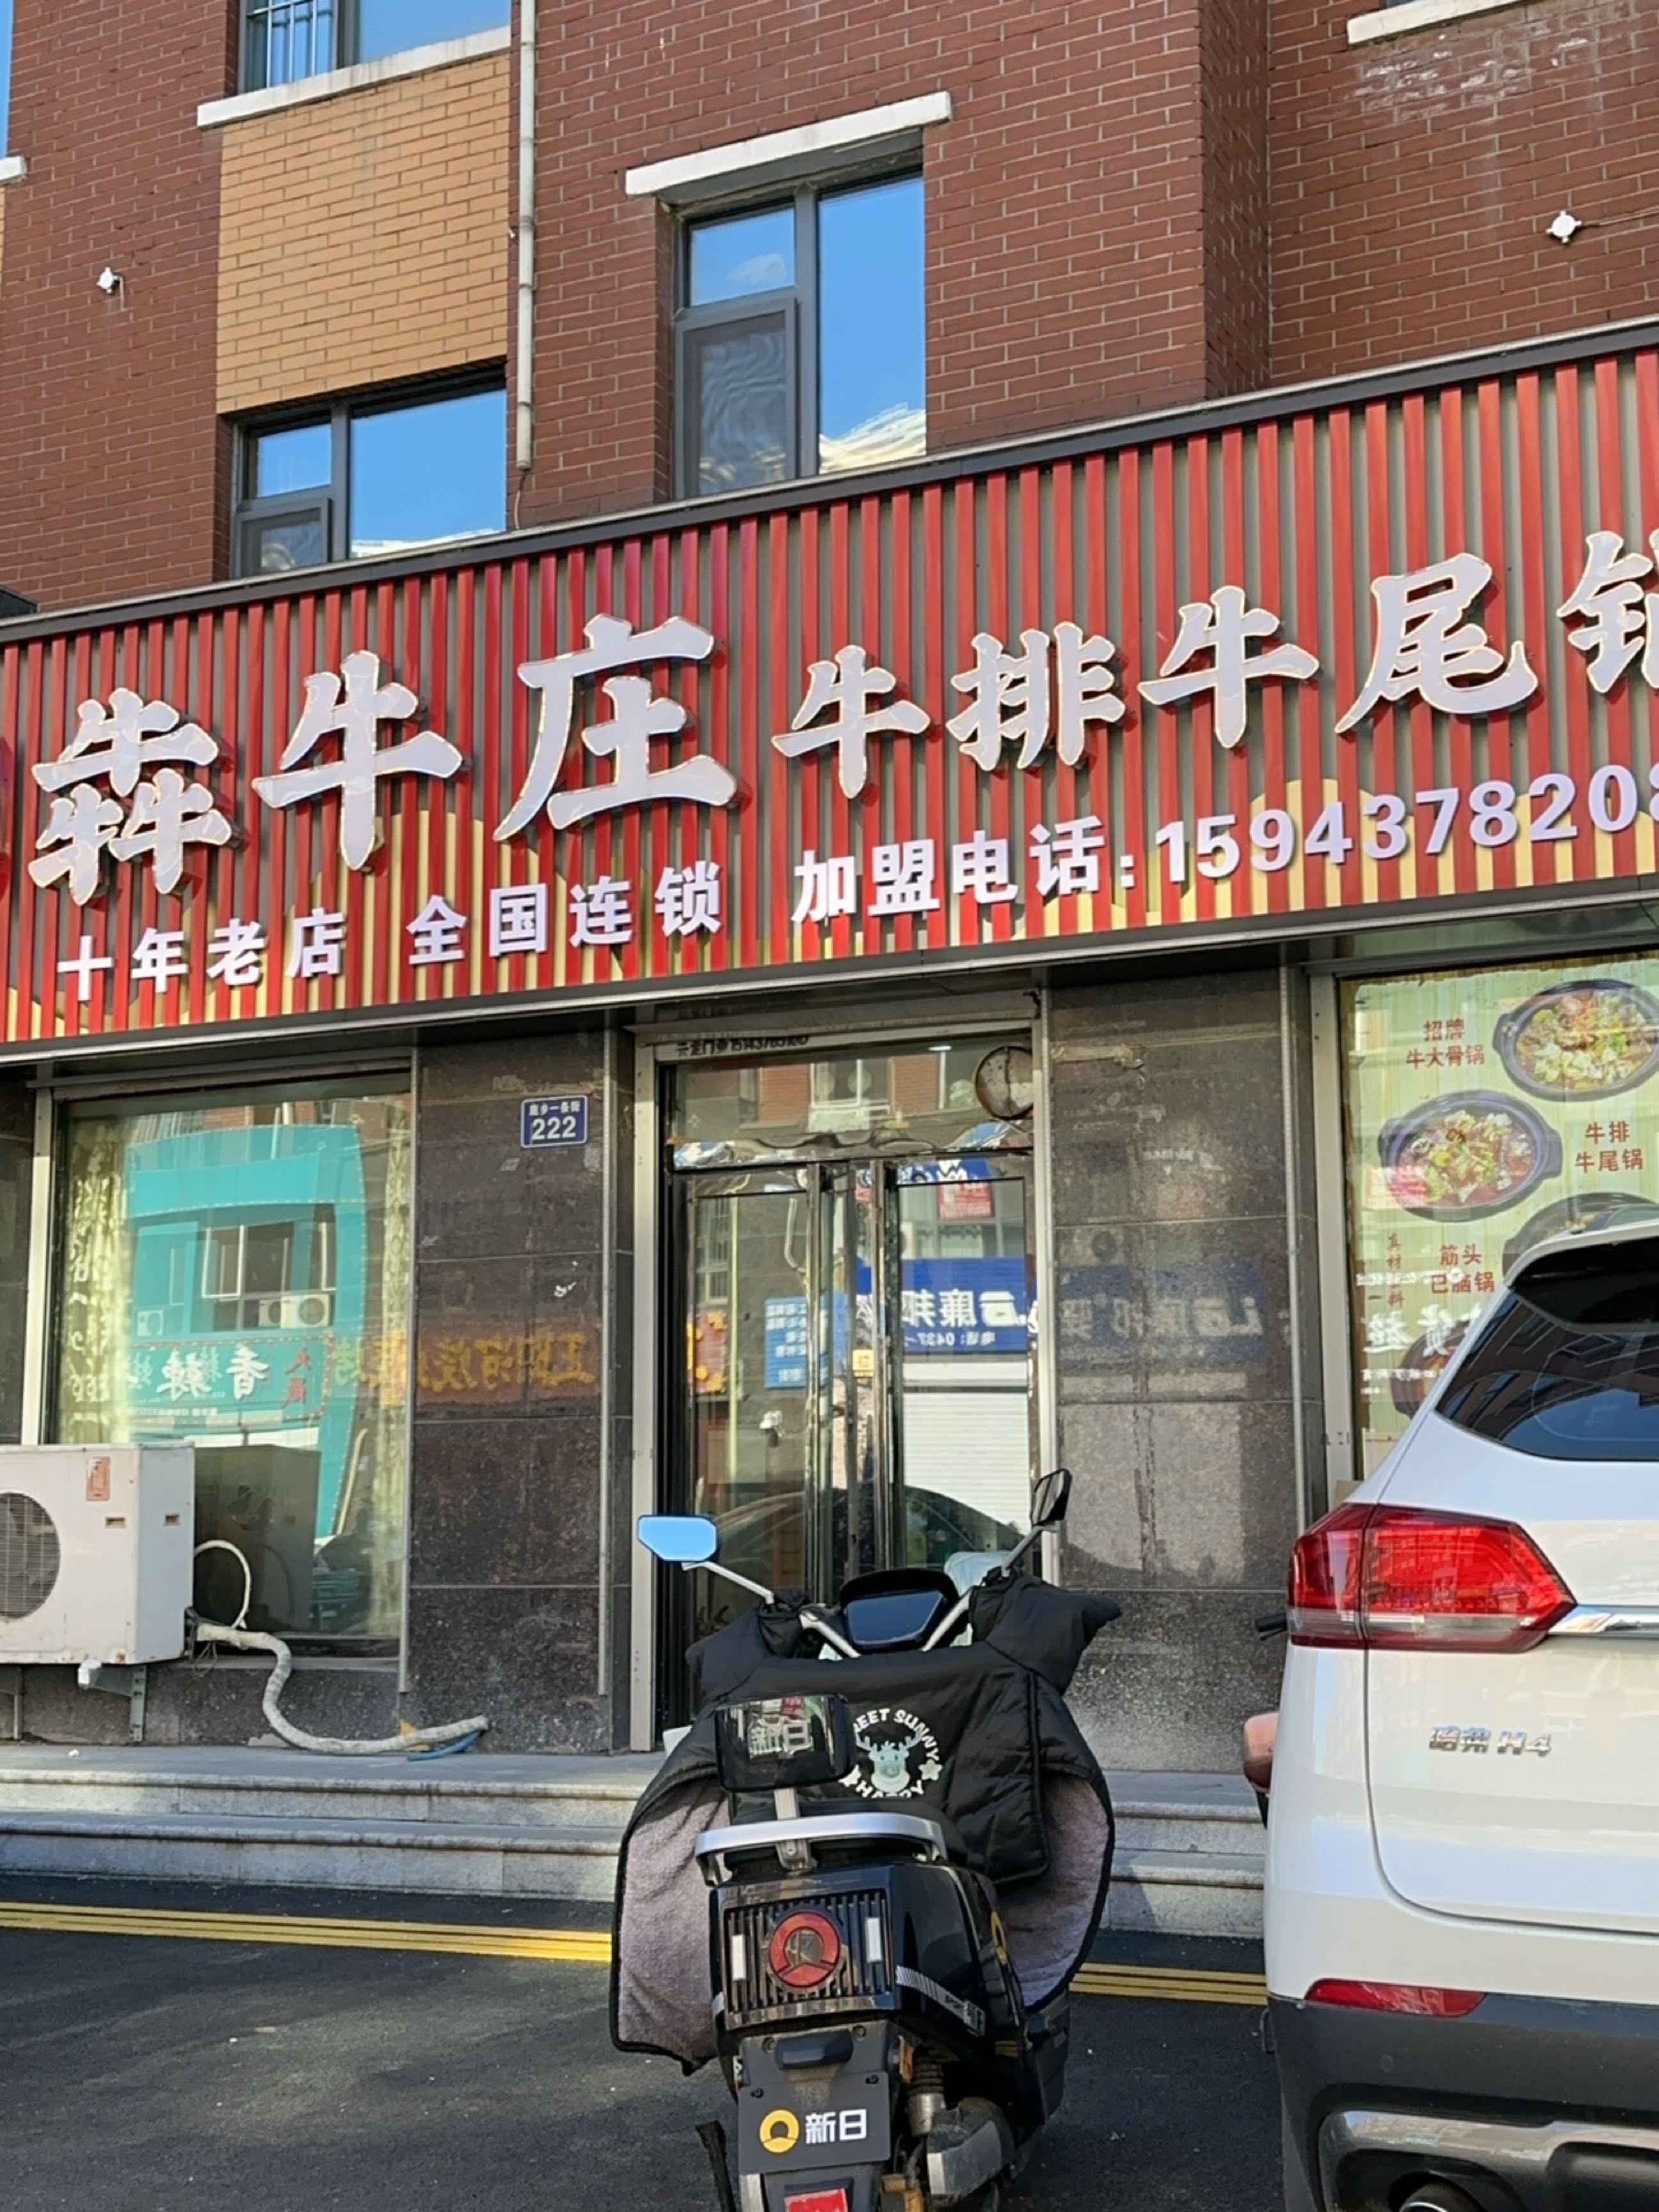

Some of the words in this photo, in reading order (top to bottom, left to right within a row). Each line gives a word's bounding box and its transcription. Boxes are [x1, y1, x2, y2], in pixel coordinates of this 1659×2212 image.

[28, 612, 737, 906] 犇牛庄
[57, 908, 345, 1002] 十年老店
[406, 859, 723, 965] 全国连锁
[791, 762, 1659, 924] 加盟电话:159437820
[1422, 1018, 1465, 1042] 招牌
[1406, 1044, 1485, 1070] 牛大骨锅
[531, 1116, 577, 1140] 222
[1585, 1121, 1630, 1144] 牛排
[1575, 1148, 1643, 1174] 牛尾锅
[1439, 1244, 1482, 1267] 筋头
[894, 1709, 940, 1761] SUNNY
[1497, 1730, 1551, 1758] H4
[805, 2108, 867, 2144] 新日
